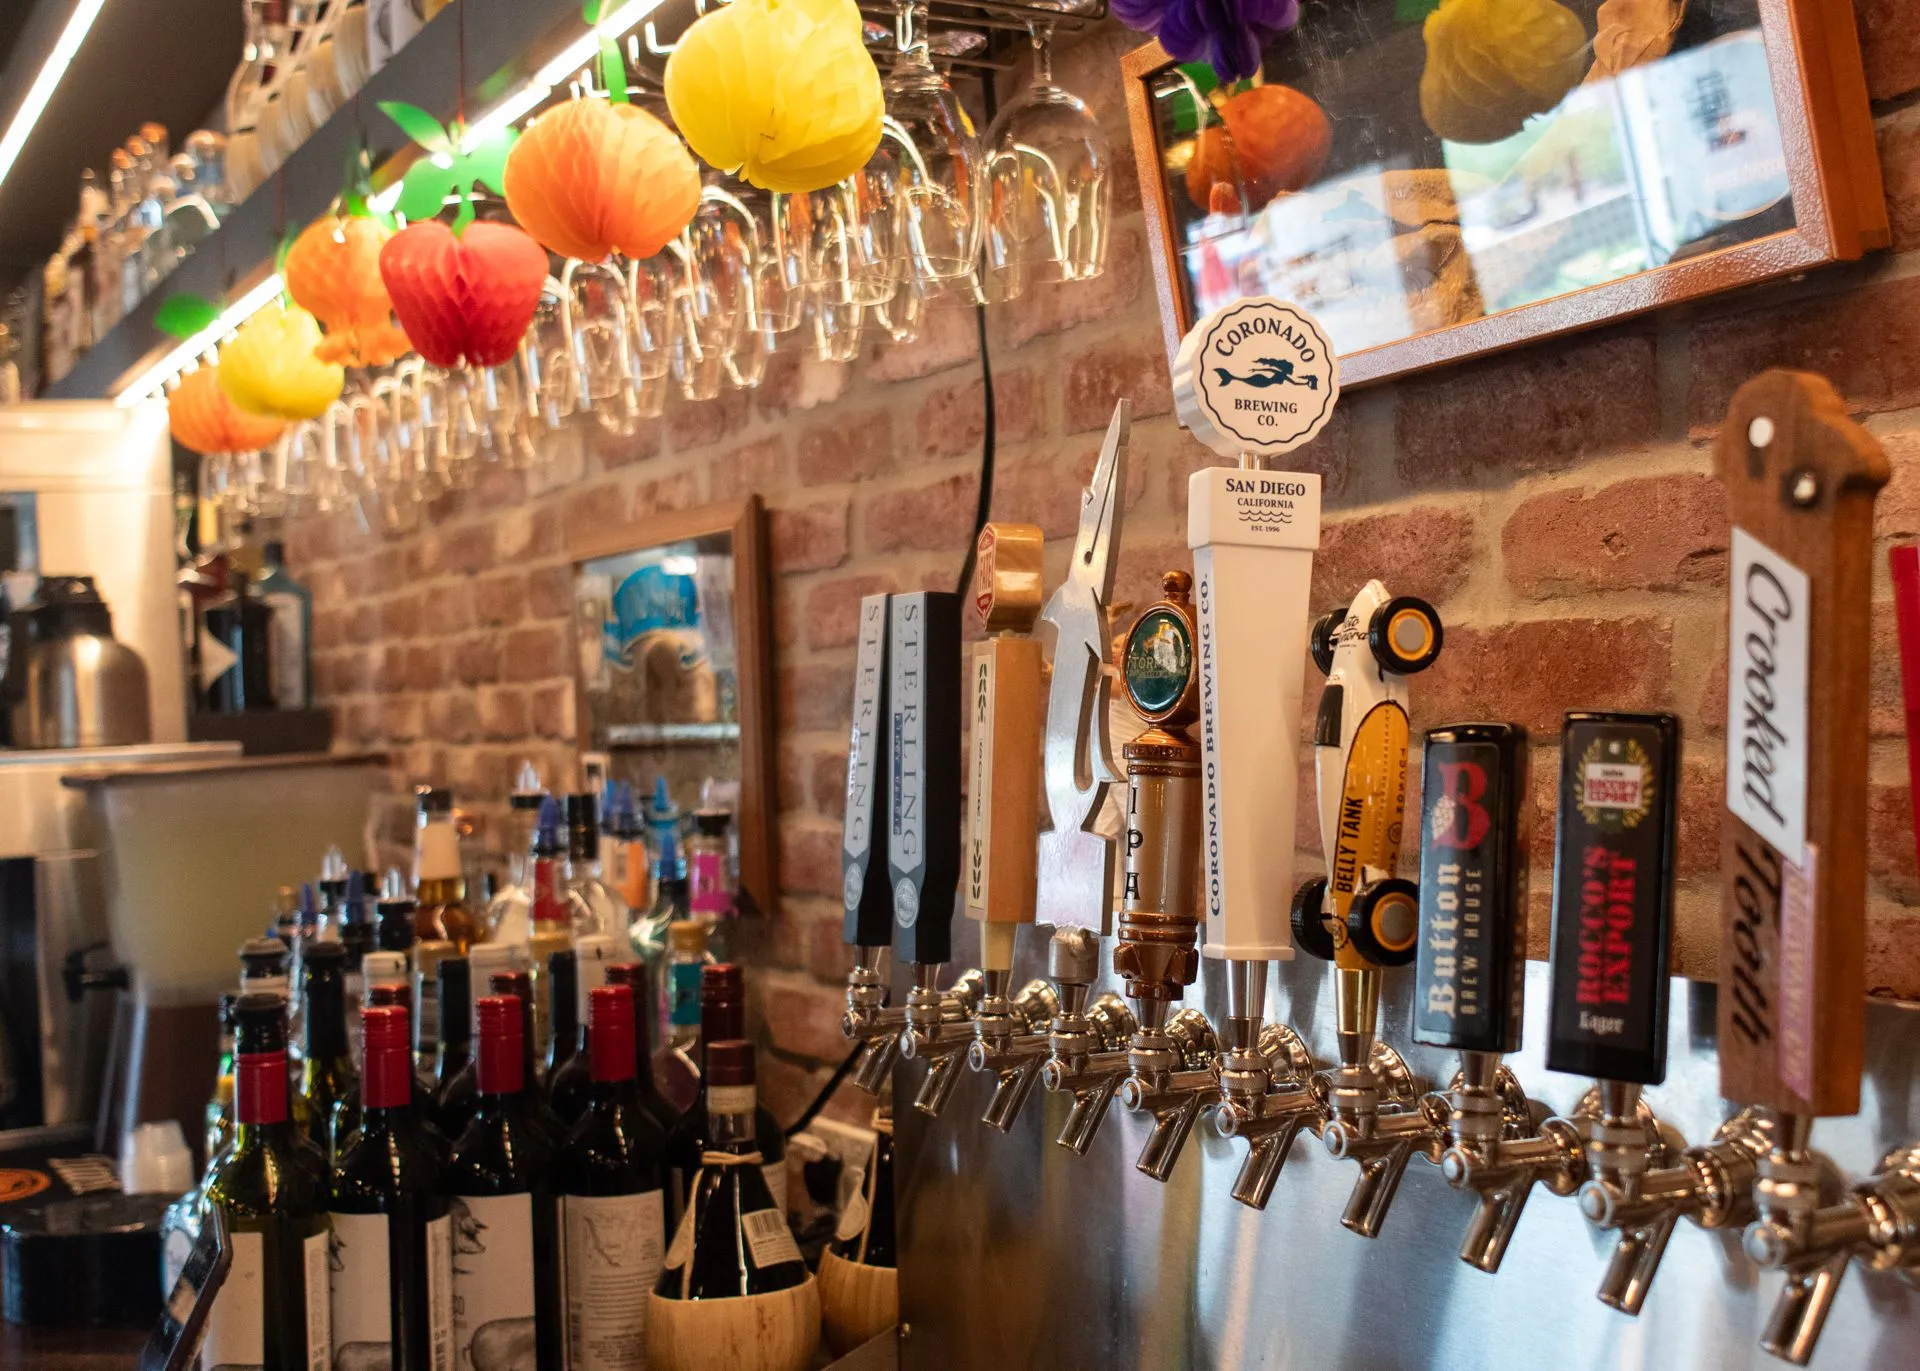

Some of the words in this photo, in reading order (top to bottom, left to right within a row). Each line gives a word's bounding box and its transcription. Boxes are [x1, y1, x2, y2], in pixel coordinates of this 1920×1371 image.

[1215, 317, 1315, 362] CORONADO
[1234, 398, 1298, 414] BREWING
[1257, 414, 1278, 427] CO.
[1226, 478, 1255, 493] SAN
[1259, 480, 1306, 496] DIEGO
[1237, 497, 1294, 509] CALIFORNIA
[1200, 573, 1209, 615] CO.
[852, 604, 879, 841] STERLING
[1202, 623, 1215, 753] BREWING
[1742, 561, 1793, 827] Crooked
[903, 604, 918, 856] STERLING
[1207, 761, 1220, 917] CORONADO
[1341, 796, 1363, 839] TANK
[1430, 761, 1491, 851] B
[1124, 787, 1144, 900] IPA
[1336, 846, 1357, 893] BELLY
[1463, 868, 1482, 938] HOUSE
[1602, 858, 1637, 1003] EXPORT
[1428, 863, 1461, 1019] Burton
[1731, 842, 1782, 1046] Tooth
[1460, 955, 1478, 1015] BREW
[1579, 1010, 1625, 1035] Lager
